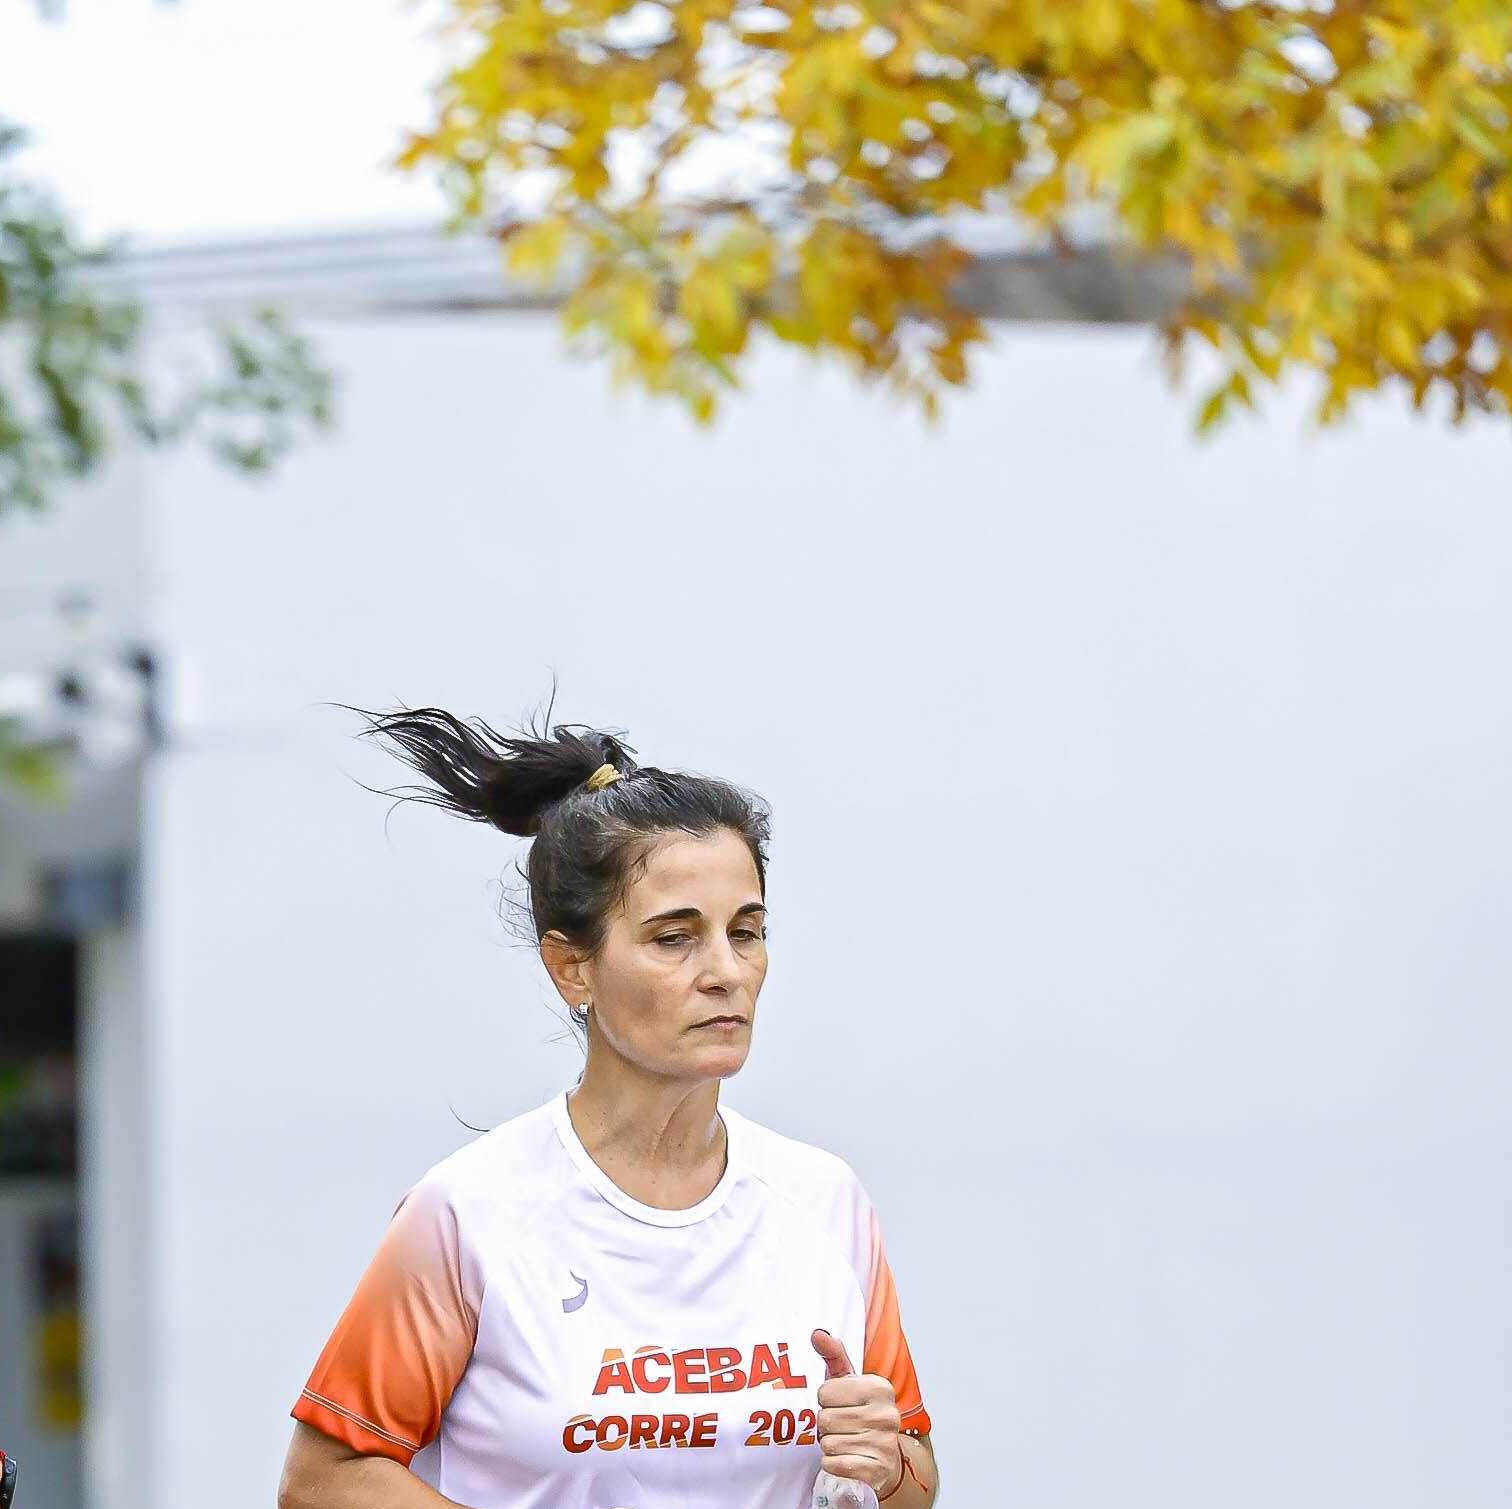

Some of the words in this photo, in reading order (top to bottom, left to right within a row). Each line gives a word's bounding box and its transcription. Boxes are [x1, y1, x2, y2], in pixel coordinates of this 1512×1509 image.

[592, 1342, 807, 1395] ACEBAL
[562, 1413, 719, 1453] CORRE
[744, 1409, 821, 1446] 202
